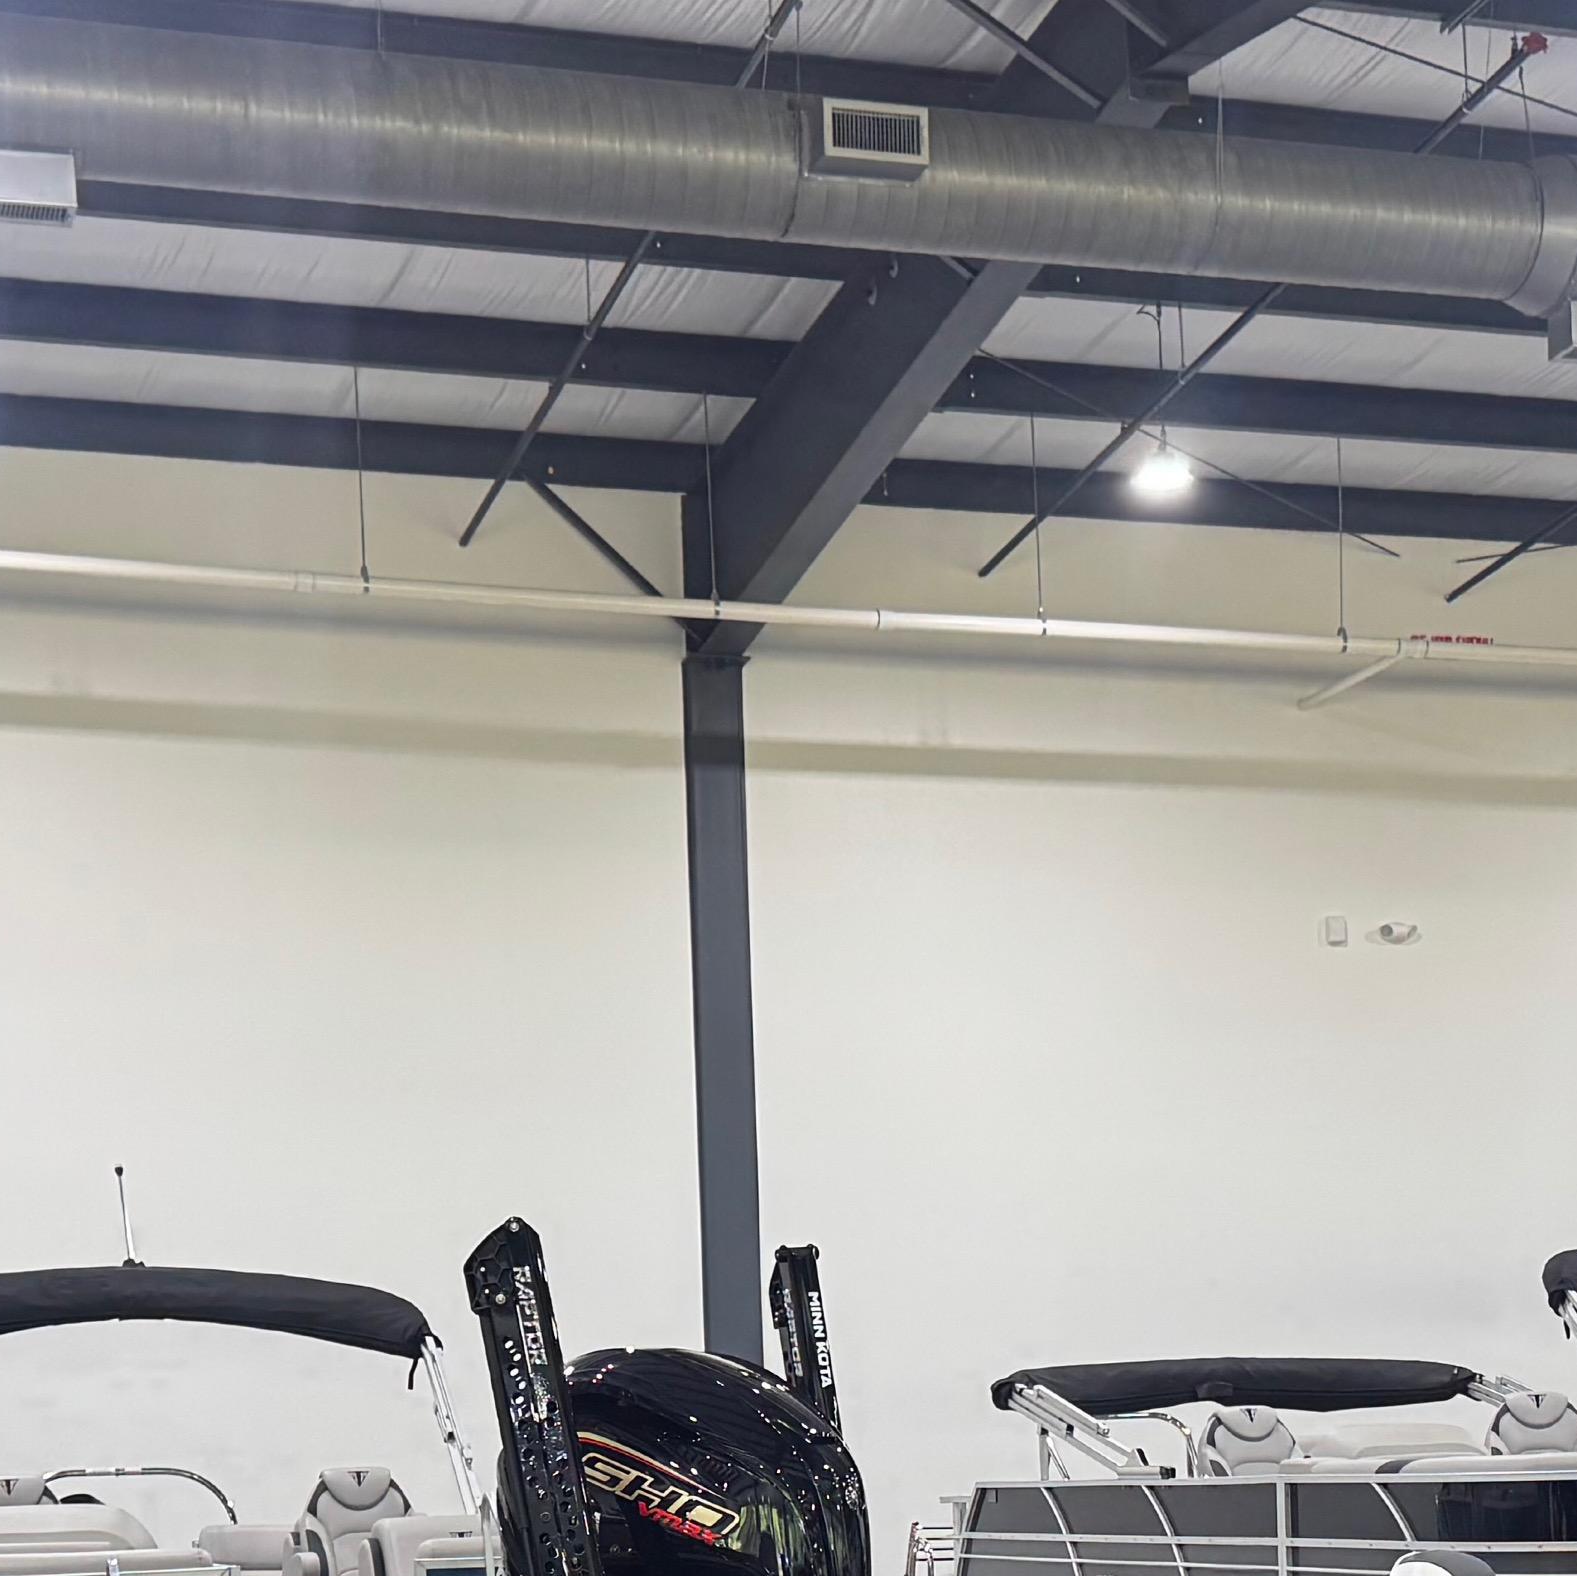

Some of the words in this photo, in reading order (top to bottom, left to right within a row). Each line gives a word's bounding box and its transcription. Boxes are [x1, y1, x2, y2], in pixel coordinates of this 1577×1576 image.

[512, 1265, 549, 1366] RAPTOR
[807, 1291, 826, 1338] MINN
[815, 1341, 833, 1388] KOTA
[581, 1452, 741, 1535] SHO
